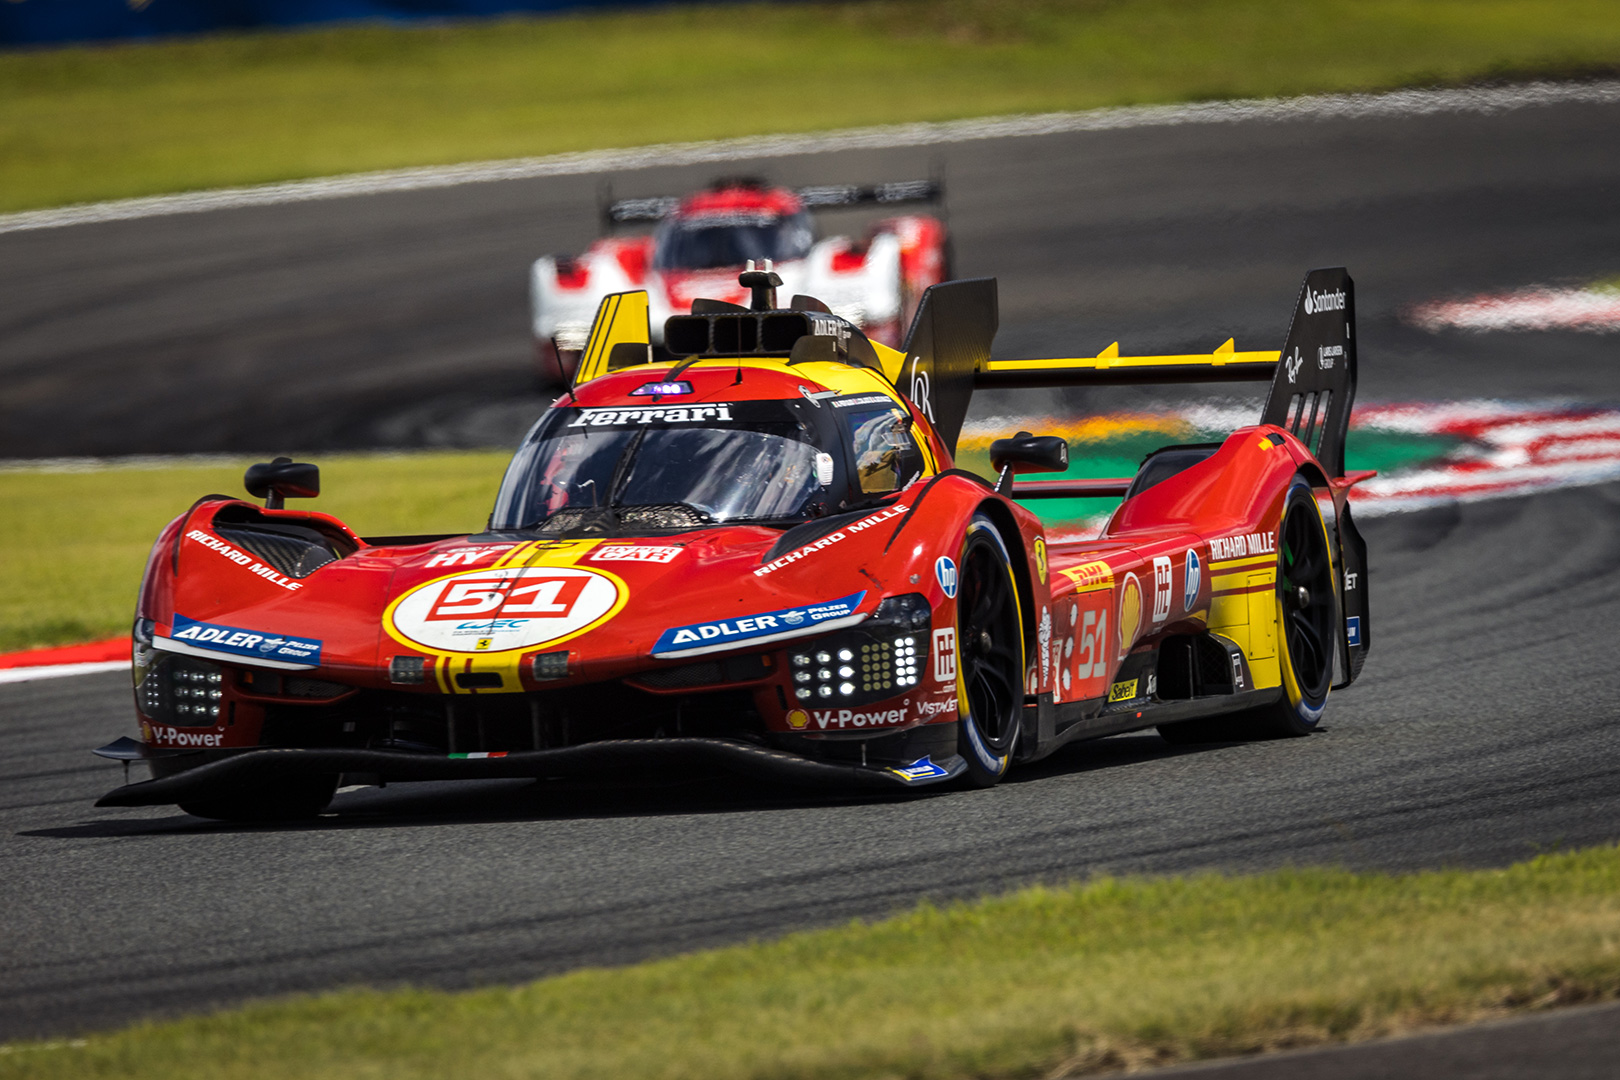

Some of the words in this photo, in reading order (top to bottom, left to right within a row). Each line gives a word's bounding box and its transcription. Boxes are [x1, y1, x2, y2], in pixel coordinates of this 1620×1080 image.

[1313, 288, 1346, 313] Santander
[567, 403, 733, 428] Ferrari
[753, 532, 846, 577] RICHARD
[847, 504, 910, 533] MILLE
[1208, 535, 1247, 560] RICHARD
[1246, 531, 1275, 555] MILLE
[186, 530, 252, 566] RICHARD
[248, 563, 304, 591] MILLE
[424, 550, 496, 568] HY
[599, 551, 669, 561] CAR
[940, 557, 956, 598] hp
[1071, 564, 1109, 587] DHL
[1186, 551, 1200, 608] hp
[436, 580, 567, 615] 51
[456, 619, 531, 630] WEC
[811, 609, 851, 620] GROUP
[173, 626, 264, 649] ADLER
[672, 615, 779, 645] ADLER
[278, 647, 312, 657] GROUP
[1078, 608, 1107, 679] 51
[813, 707, 908, 730] V-Power
[152, 726, 224, 747] V-Power
